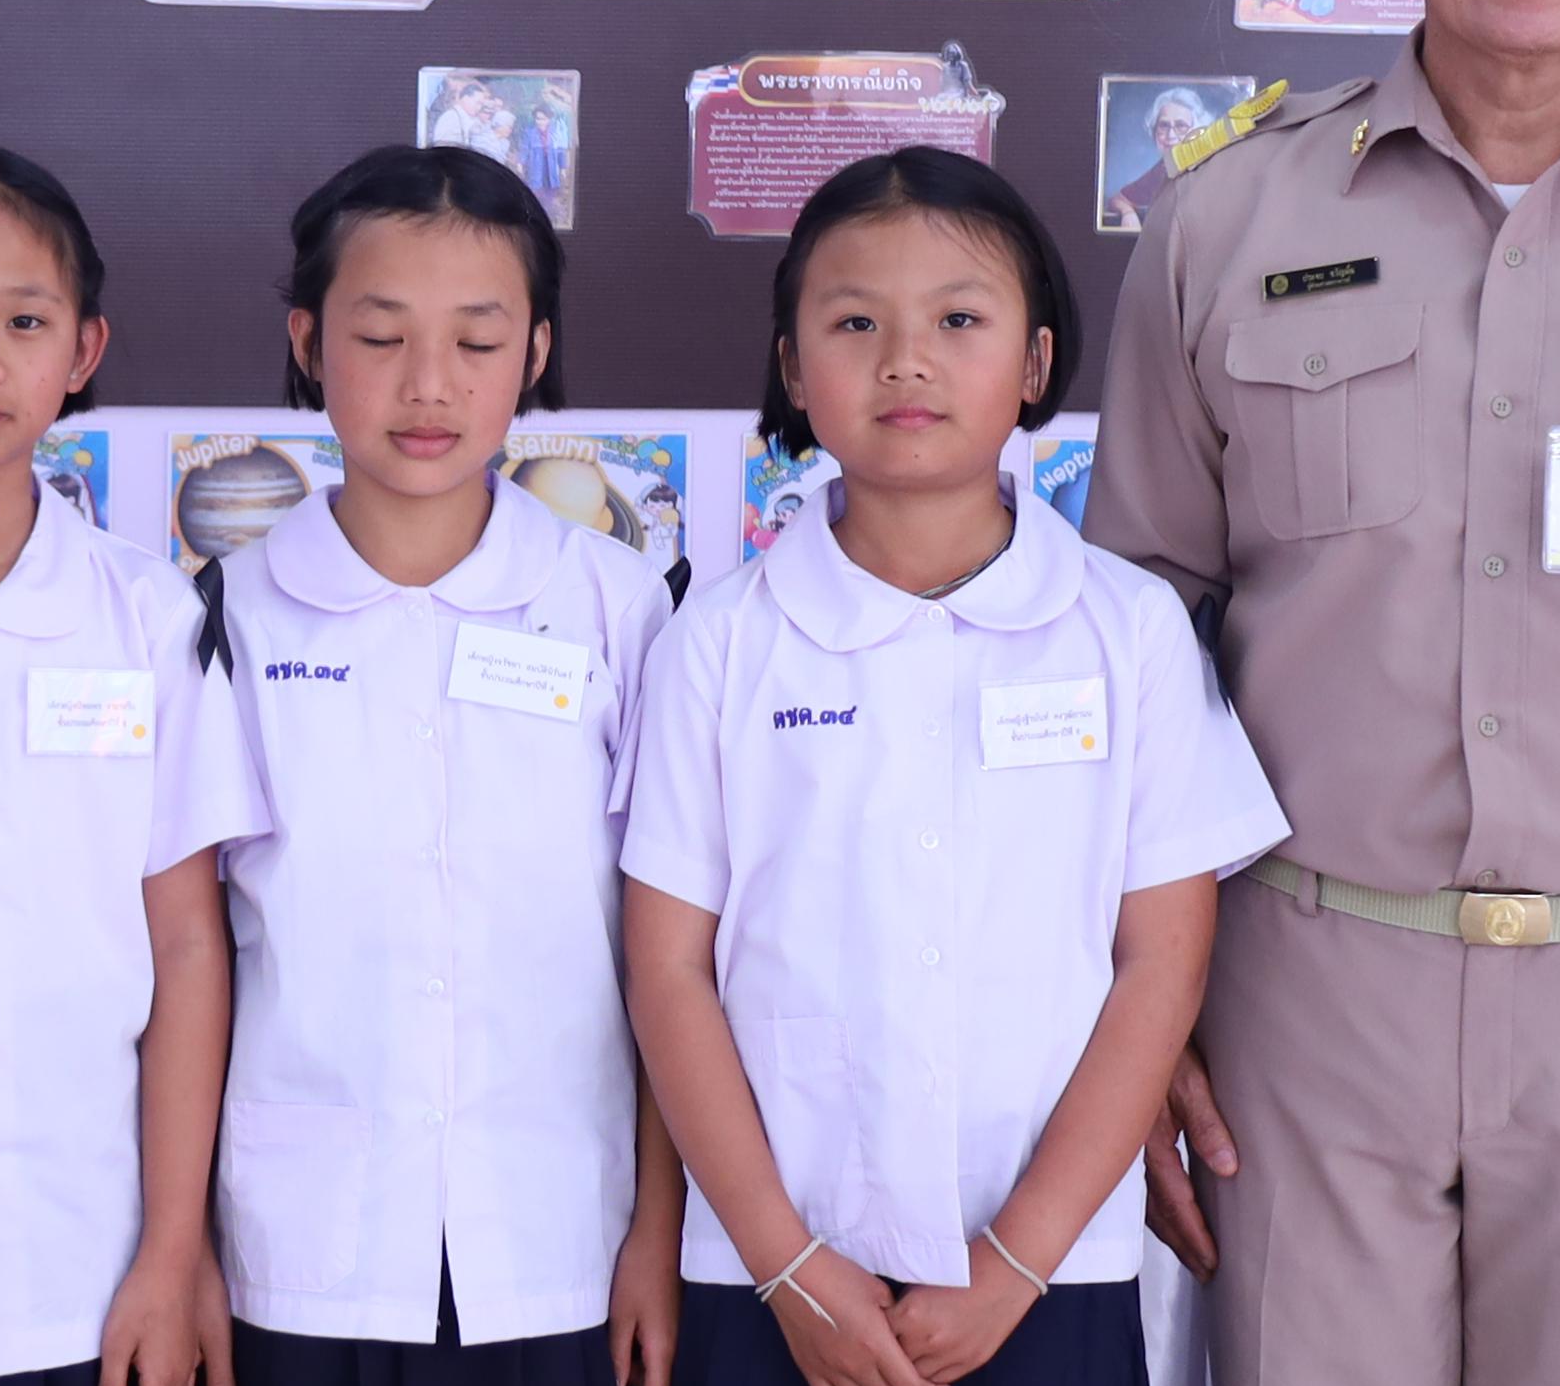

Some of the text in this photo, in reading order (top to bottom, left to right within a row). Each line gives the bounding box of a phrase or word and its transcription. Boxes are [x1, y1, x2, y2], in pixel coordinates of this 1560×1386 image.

[758, 69, 922, 91] พระราชกรณียกิจ
[177, 435, 259, 471] Jupiter
[1039, 445, 1095, 493] Neptu
